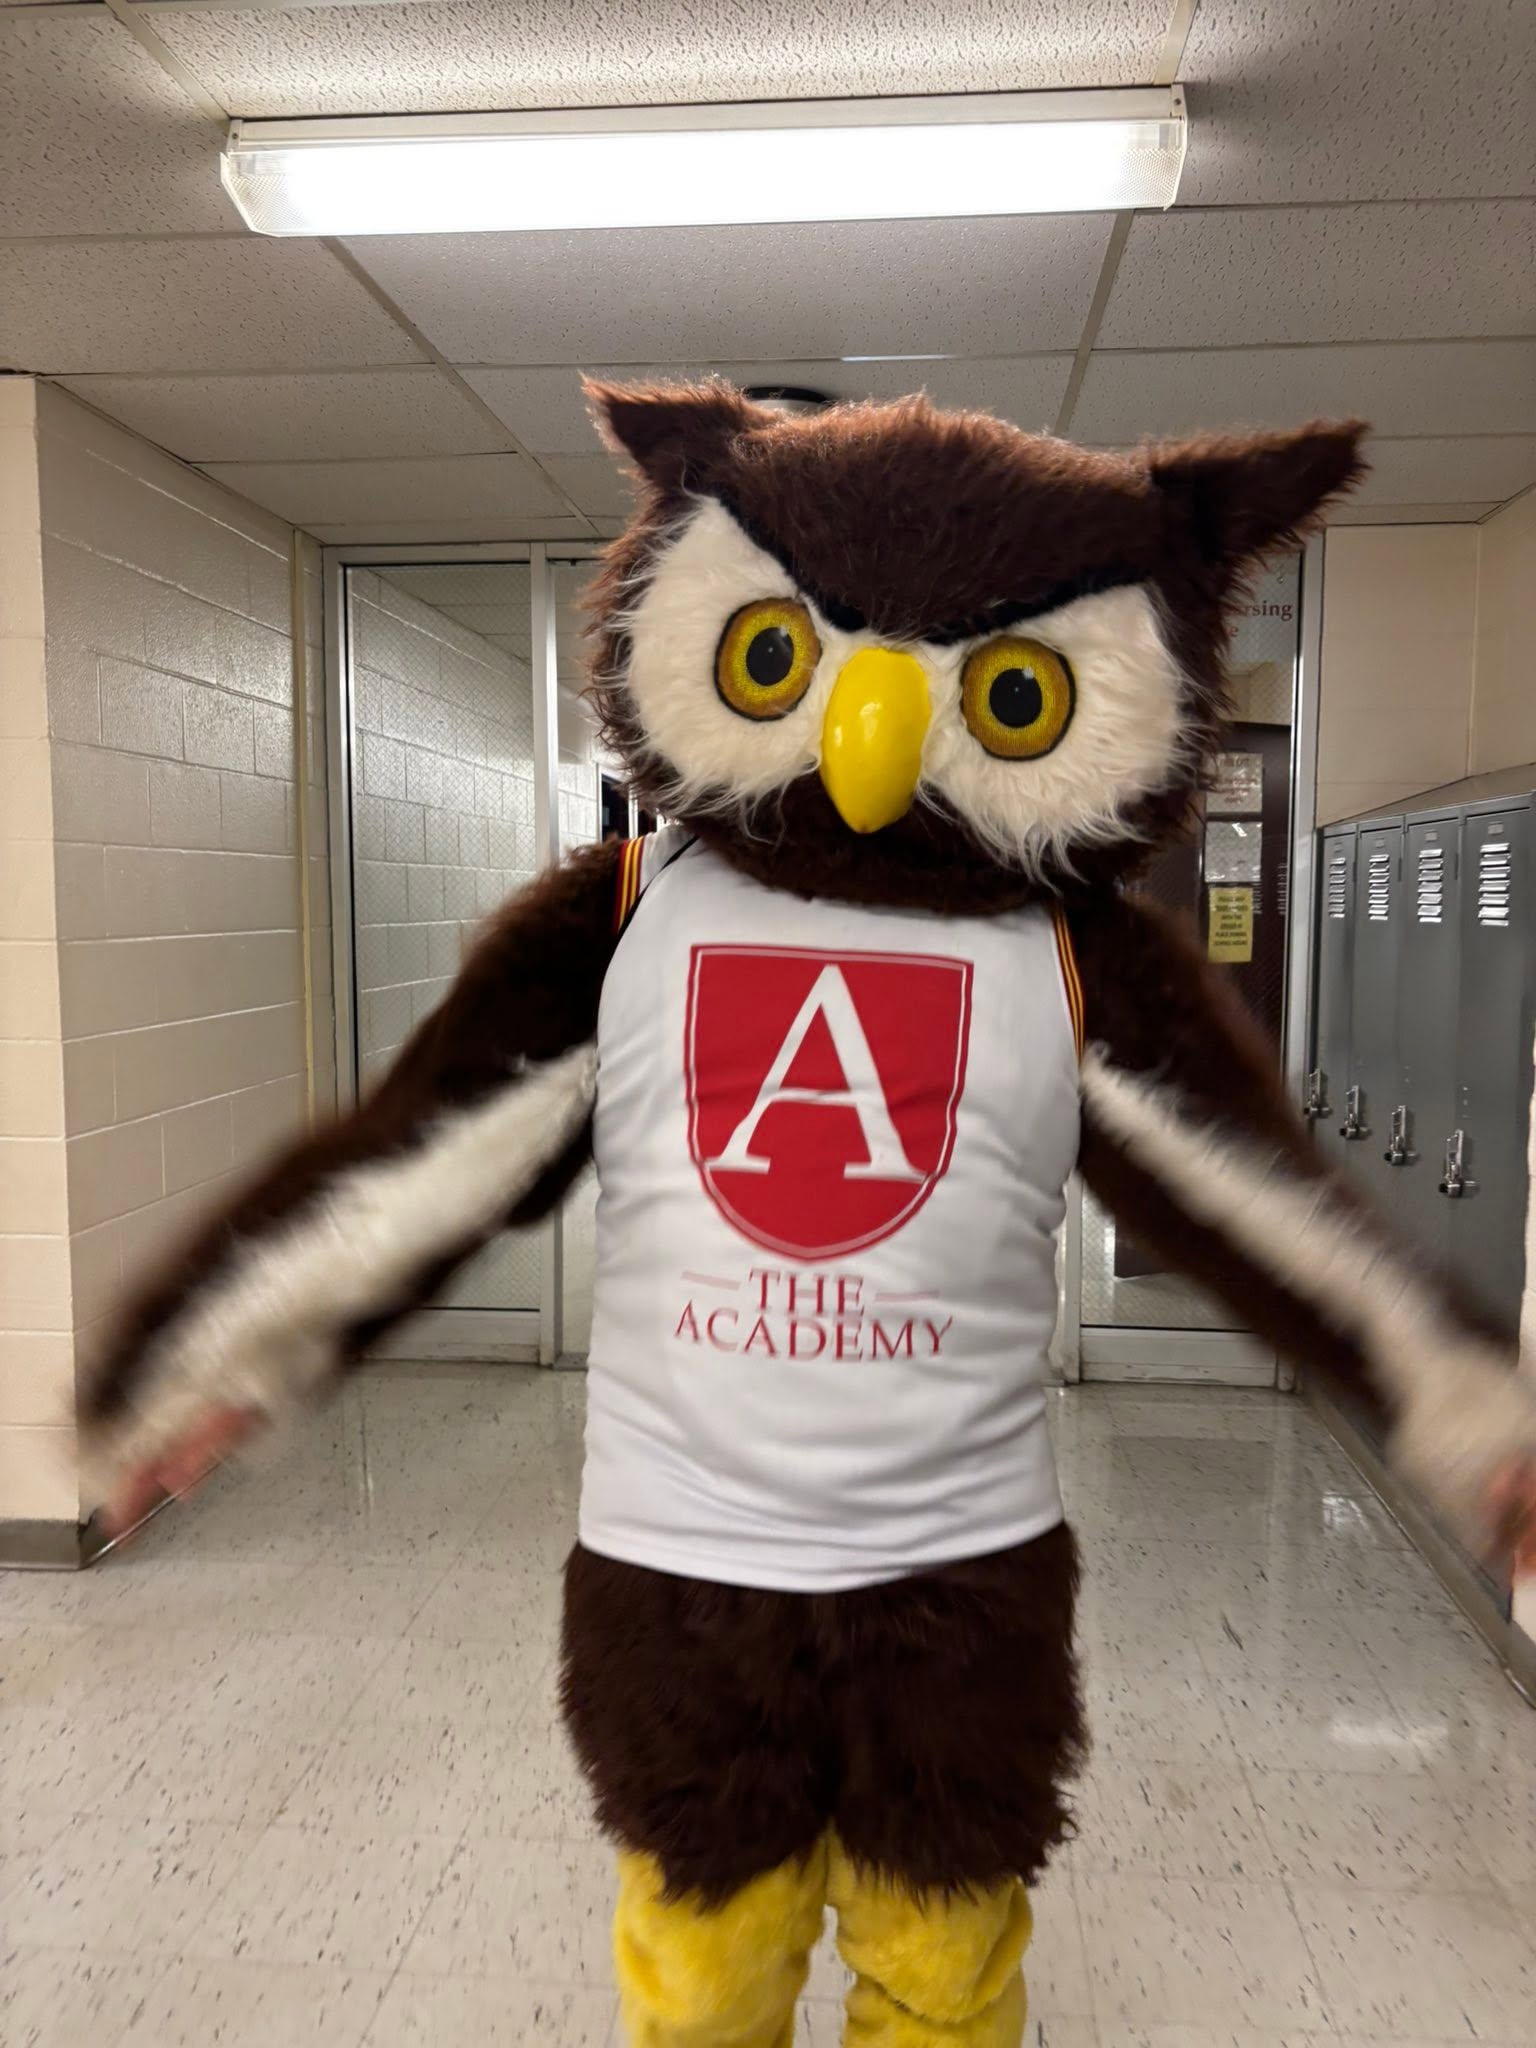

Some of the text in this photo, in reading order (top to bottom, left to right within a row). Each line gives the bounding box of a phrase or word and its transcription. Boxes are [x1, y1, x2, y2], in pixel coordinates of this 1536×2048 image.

[703, 963, 927, 1184] A
[749, 1267, 864, 1317] THE
[675, 1299, 953, 1362] ACADEMY
